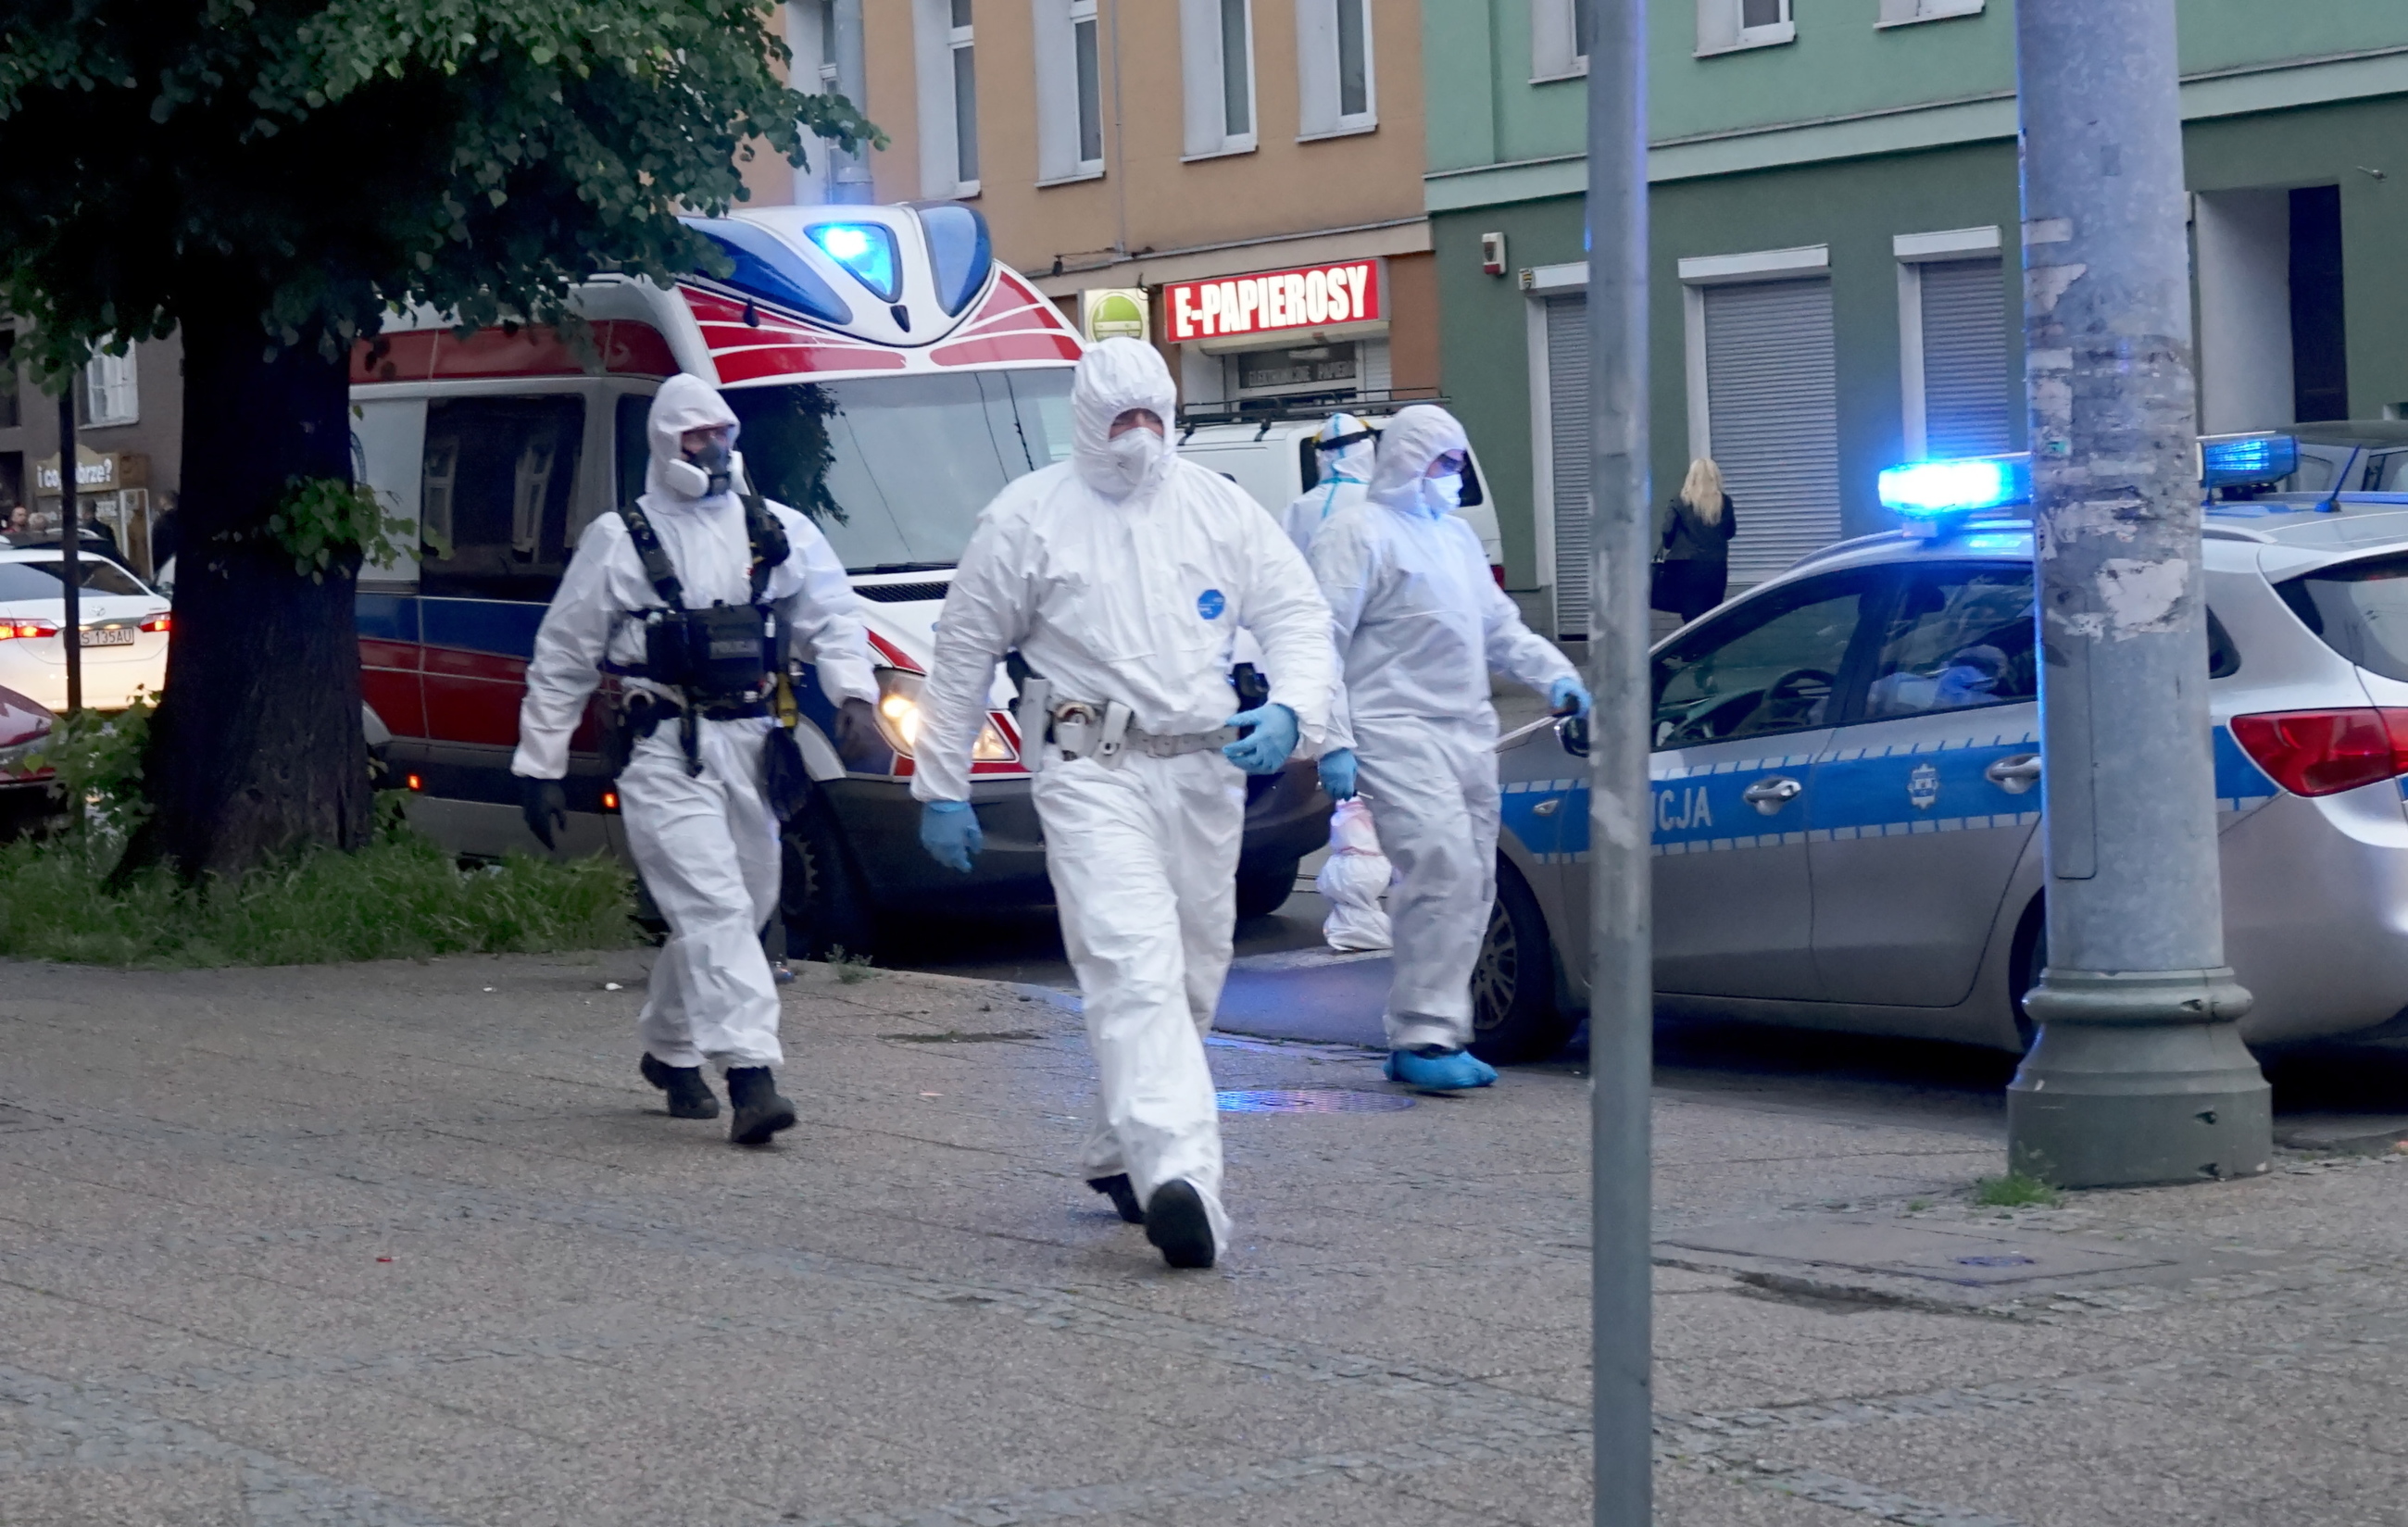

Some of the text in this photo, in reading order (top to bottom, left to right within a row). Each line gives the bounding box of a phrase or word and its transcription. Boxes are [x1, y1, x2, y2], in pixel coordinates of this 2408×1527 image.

[1174, 265, 1368, 338] E-PAPIEROSY
[75, 457, 112, 484] brze?
[95, 630, 132, 644] 135AU
[1649, 786, 1712, 832] ICJA
